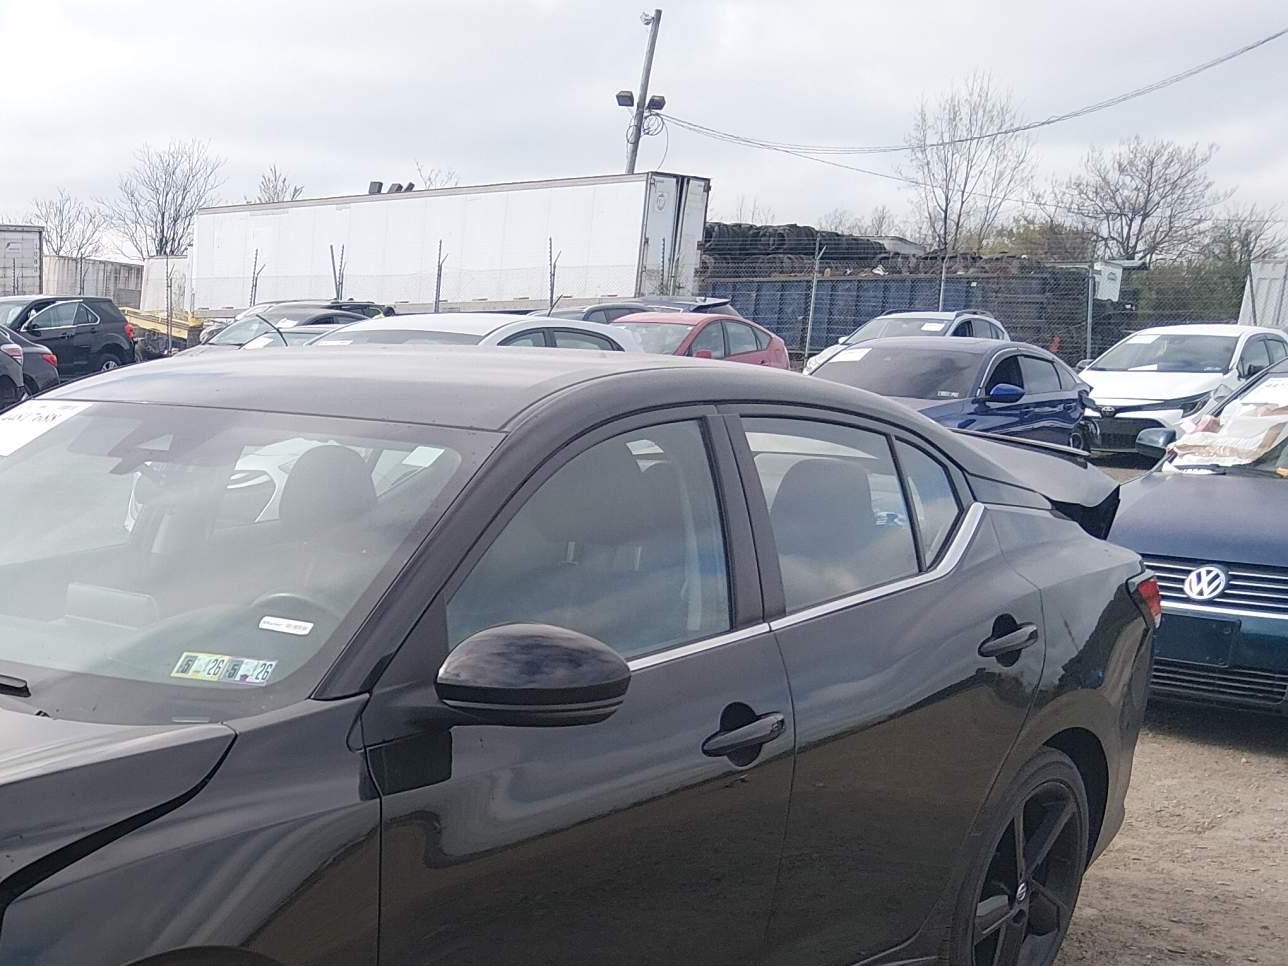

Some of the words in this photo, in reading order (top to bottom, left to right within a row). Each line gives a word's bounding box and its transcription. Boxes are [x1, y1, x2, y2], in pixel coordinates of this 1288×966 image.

[1185, 567, 1225, 599] VW
[207, 659, 225, 676] 26
[228, 663, 240, 679] 5
[255, 663, 273, 681] 26
